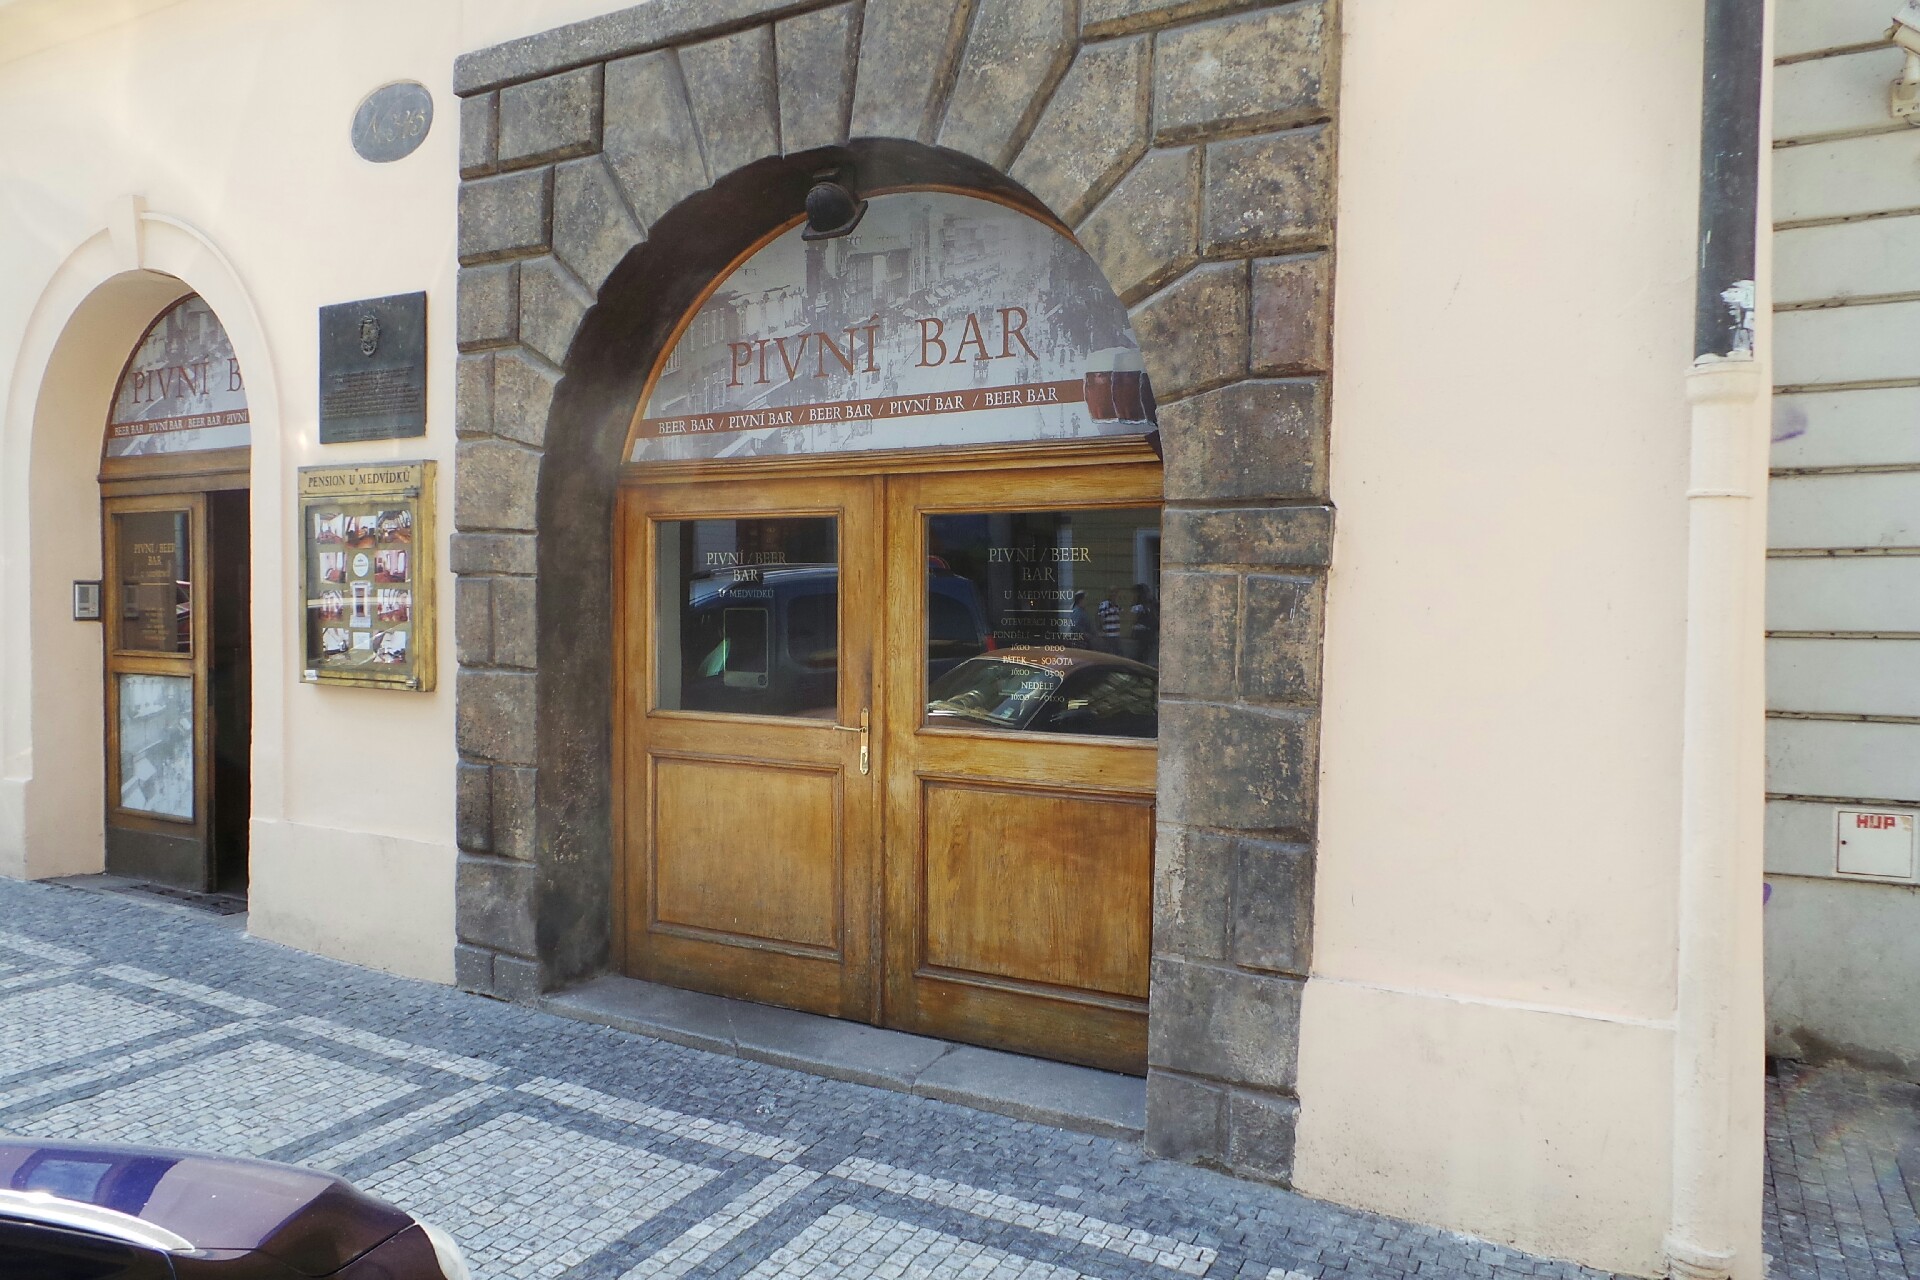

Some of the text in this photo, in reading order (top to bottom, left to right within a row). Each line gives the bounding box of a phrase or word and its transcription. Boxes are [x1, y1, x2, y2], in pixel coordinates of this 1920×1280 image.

[726, 306, 1039, 387] PIVNÍ BAR
[132, 355, 209, 404] PIVNÍ
[658, 420, 686, 434] BEER
[691, 418, 715, 432] BAR
[729, 411, 765, 429] PIVNÍ
[768, 411, 794, 425] BAR
[809, 407, 842, 421] BEER
[845, 404, 873, 418] BAR
[889, 396, 930, 415] PIVNÍ
[935, 396, 964, 411] BAR
[985, 391, 1022, 406] BEER
[1027, 388, 1058, 402] BAR
[115, 425, 130, 436] BEER
[131, 424, 144, 435] BAR
[148, 420, 169, 432] PIVNÍ
[169, 420, 183, 430] BAR
[188, 417, 204, 428] BEER
[207, 416, 221, 425] BAR
[226, 411, 247, 424] PIVNÍ
[308, 469, 410, 487] PENSION U MEDVÍDKŮ
[706, 550, 744, 565] PIVNÍ
[755, 552, 787, 565] BEER
[988, 545, 1036, 562] PIVNÍ
[1050, 547, 1091, 563] BEER
[733, 569, 759, 582] BAR
[1023, 567, 1055, 582] BAR
[1004, 590, 1012, 599] U
[1041, 657, 1073, 666] SOBOTA
[1856, 814, 1896, 830] HUP
